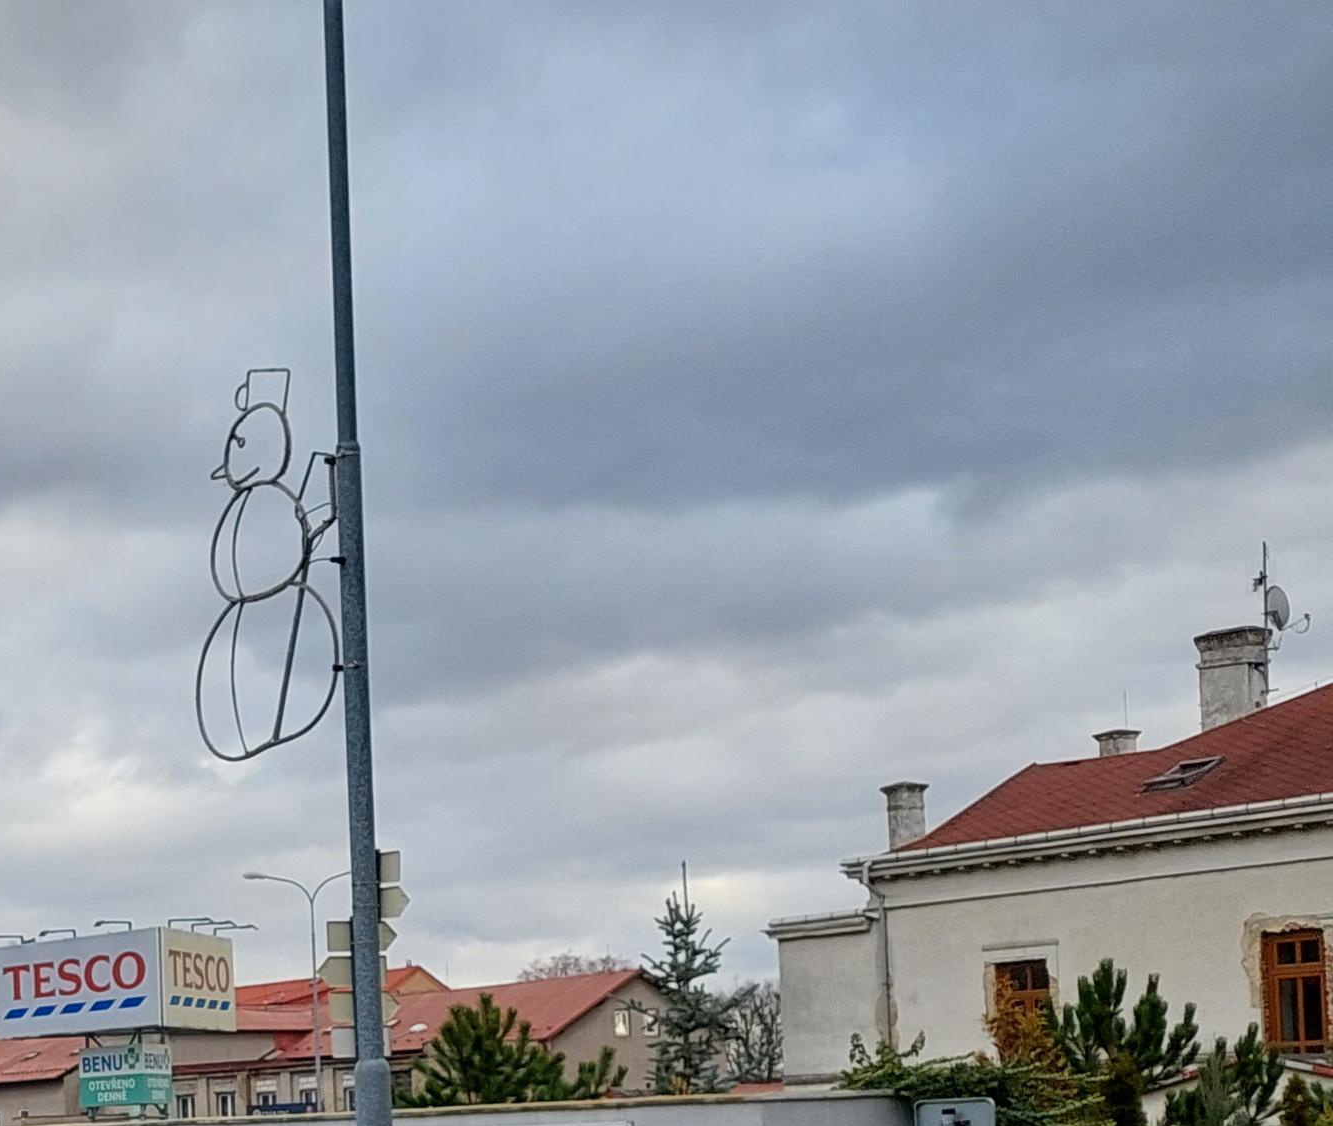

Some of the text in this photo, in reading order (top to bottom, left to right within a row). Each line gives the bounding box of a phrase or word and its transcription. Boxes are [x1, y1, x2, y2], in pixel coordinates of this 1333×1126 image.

[2, 951, 146, 1001] TESCO
[168, 949, 230, 993] TESCO
[82, 1053, 123, 1073] BENU
[88, 1076, 136, 1092] OTEVŘENO
[97, 1088, 128, 1103] DENNĚ
